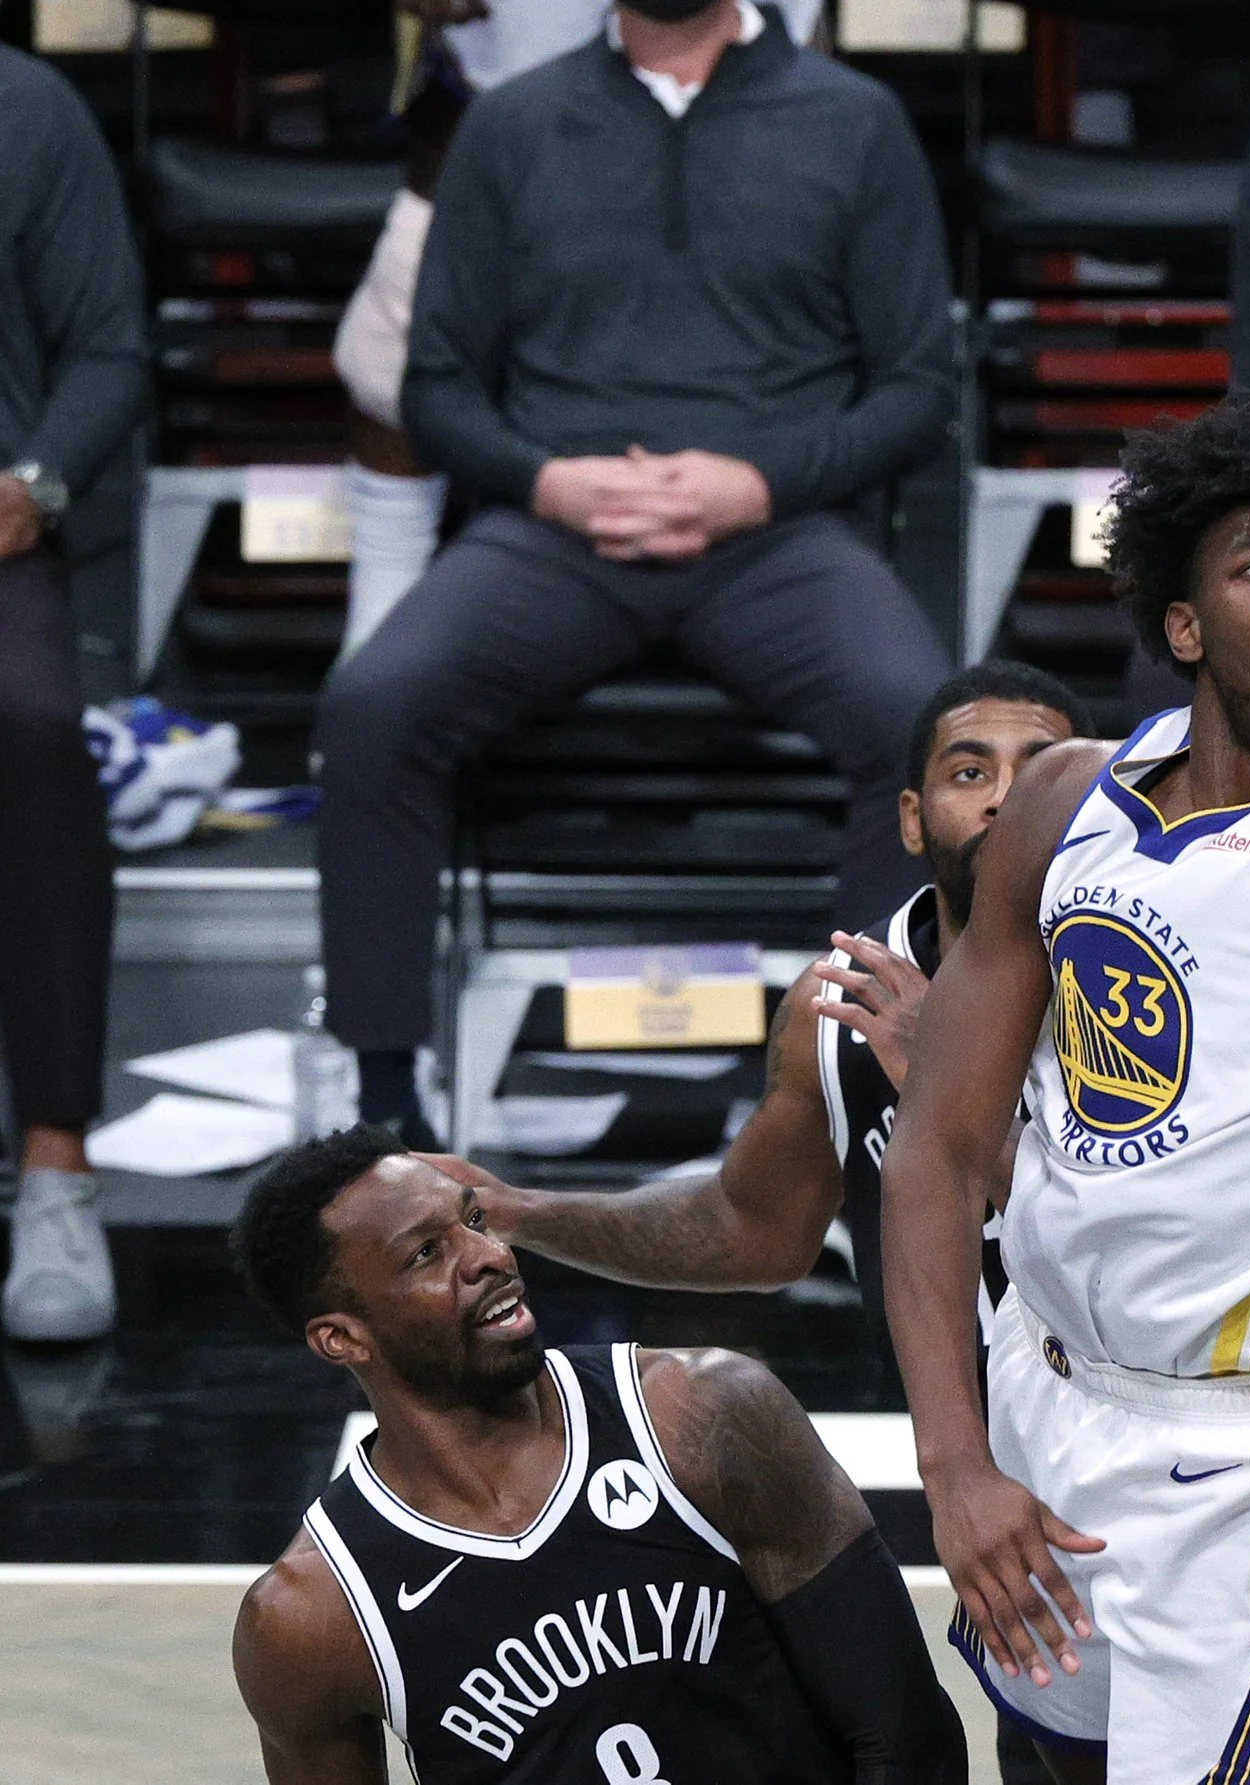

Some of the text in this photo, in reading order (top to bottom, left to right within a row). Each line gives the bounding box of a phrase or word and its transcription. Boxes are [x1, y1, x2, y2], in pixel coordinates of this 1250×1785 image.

[1128, 898, 1200, 977] STATE
[1100, 964, 1169, 1037] 33
[440, 1581, 726, 1762] BROOKLYN
